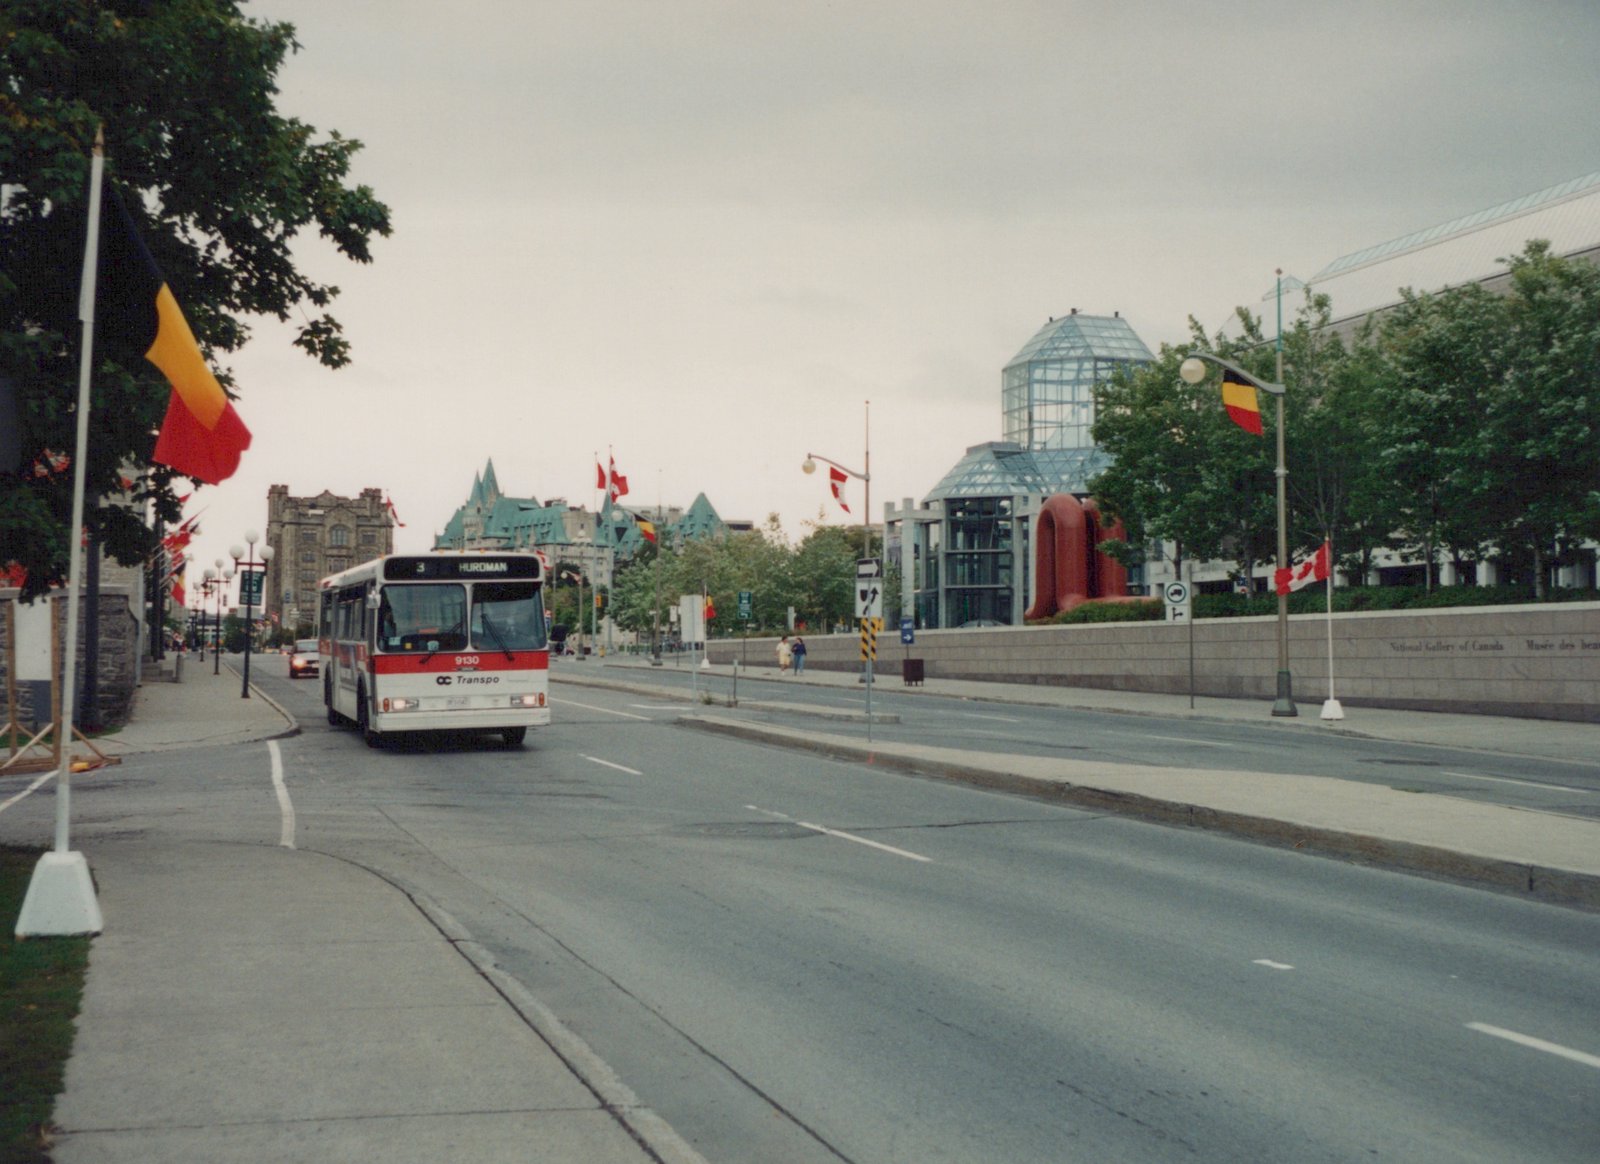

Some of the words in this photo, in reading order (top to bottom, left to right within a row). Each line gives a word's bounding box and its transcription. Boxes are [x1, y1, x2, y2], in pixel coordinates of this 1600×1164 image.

[416, 562, 425, 572] 3
[459, 562, 507, 572] HURDMAN
[1390, 641, 1422, 651] National
[1425, 640, 1454, 652] Gallery
[1459, 640, 1469, 651] of
[1472, 640, 1504, 651] Canada
[1526, 639, 1554, 650] Musée
[1559, 639, 1575, 650] des
[455, 656, 479, 665] 9130
[457, 676, 500, 684] Transpo
